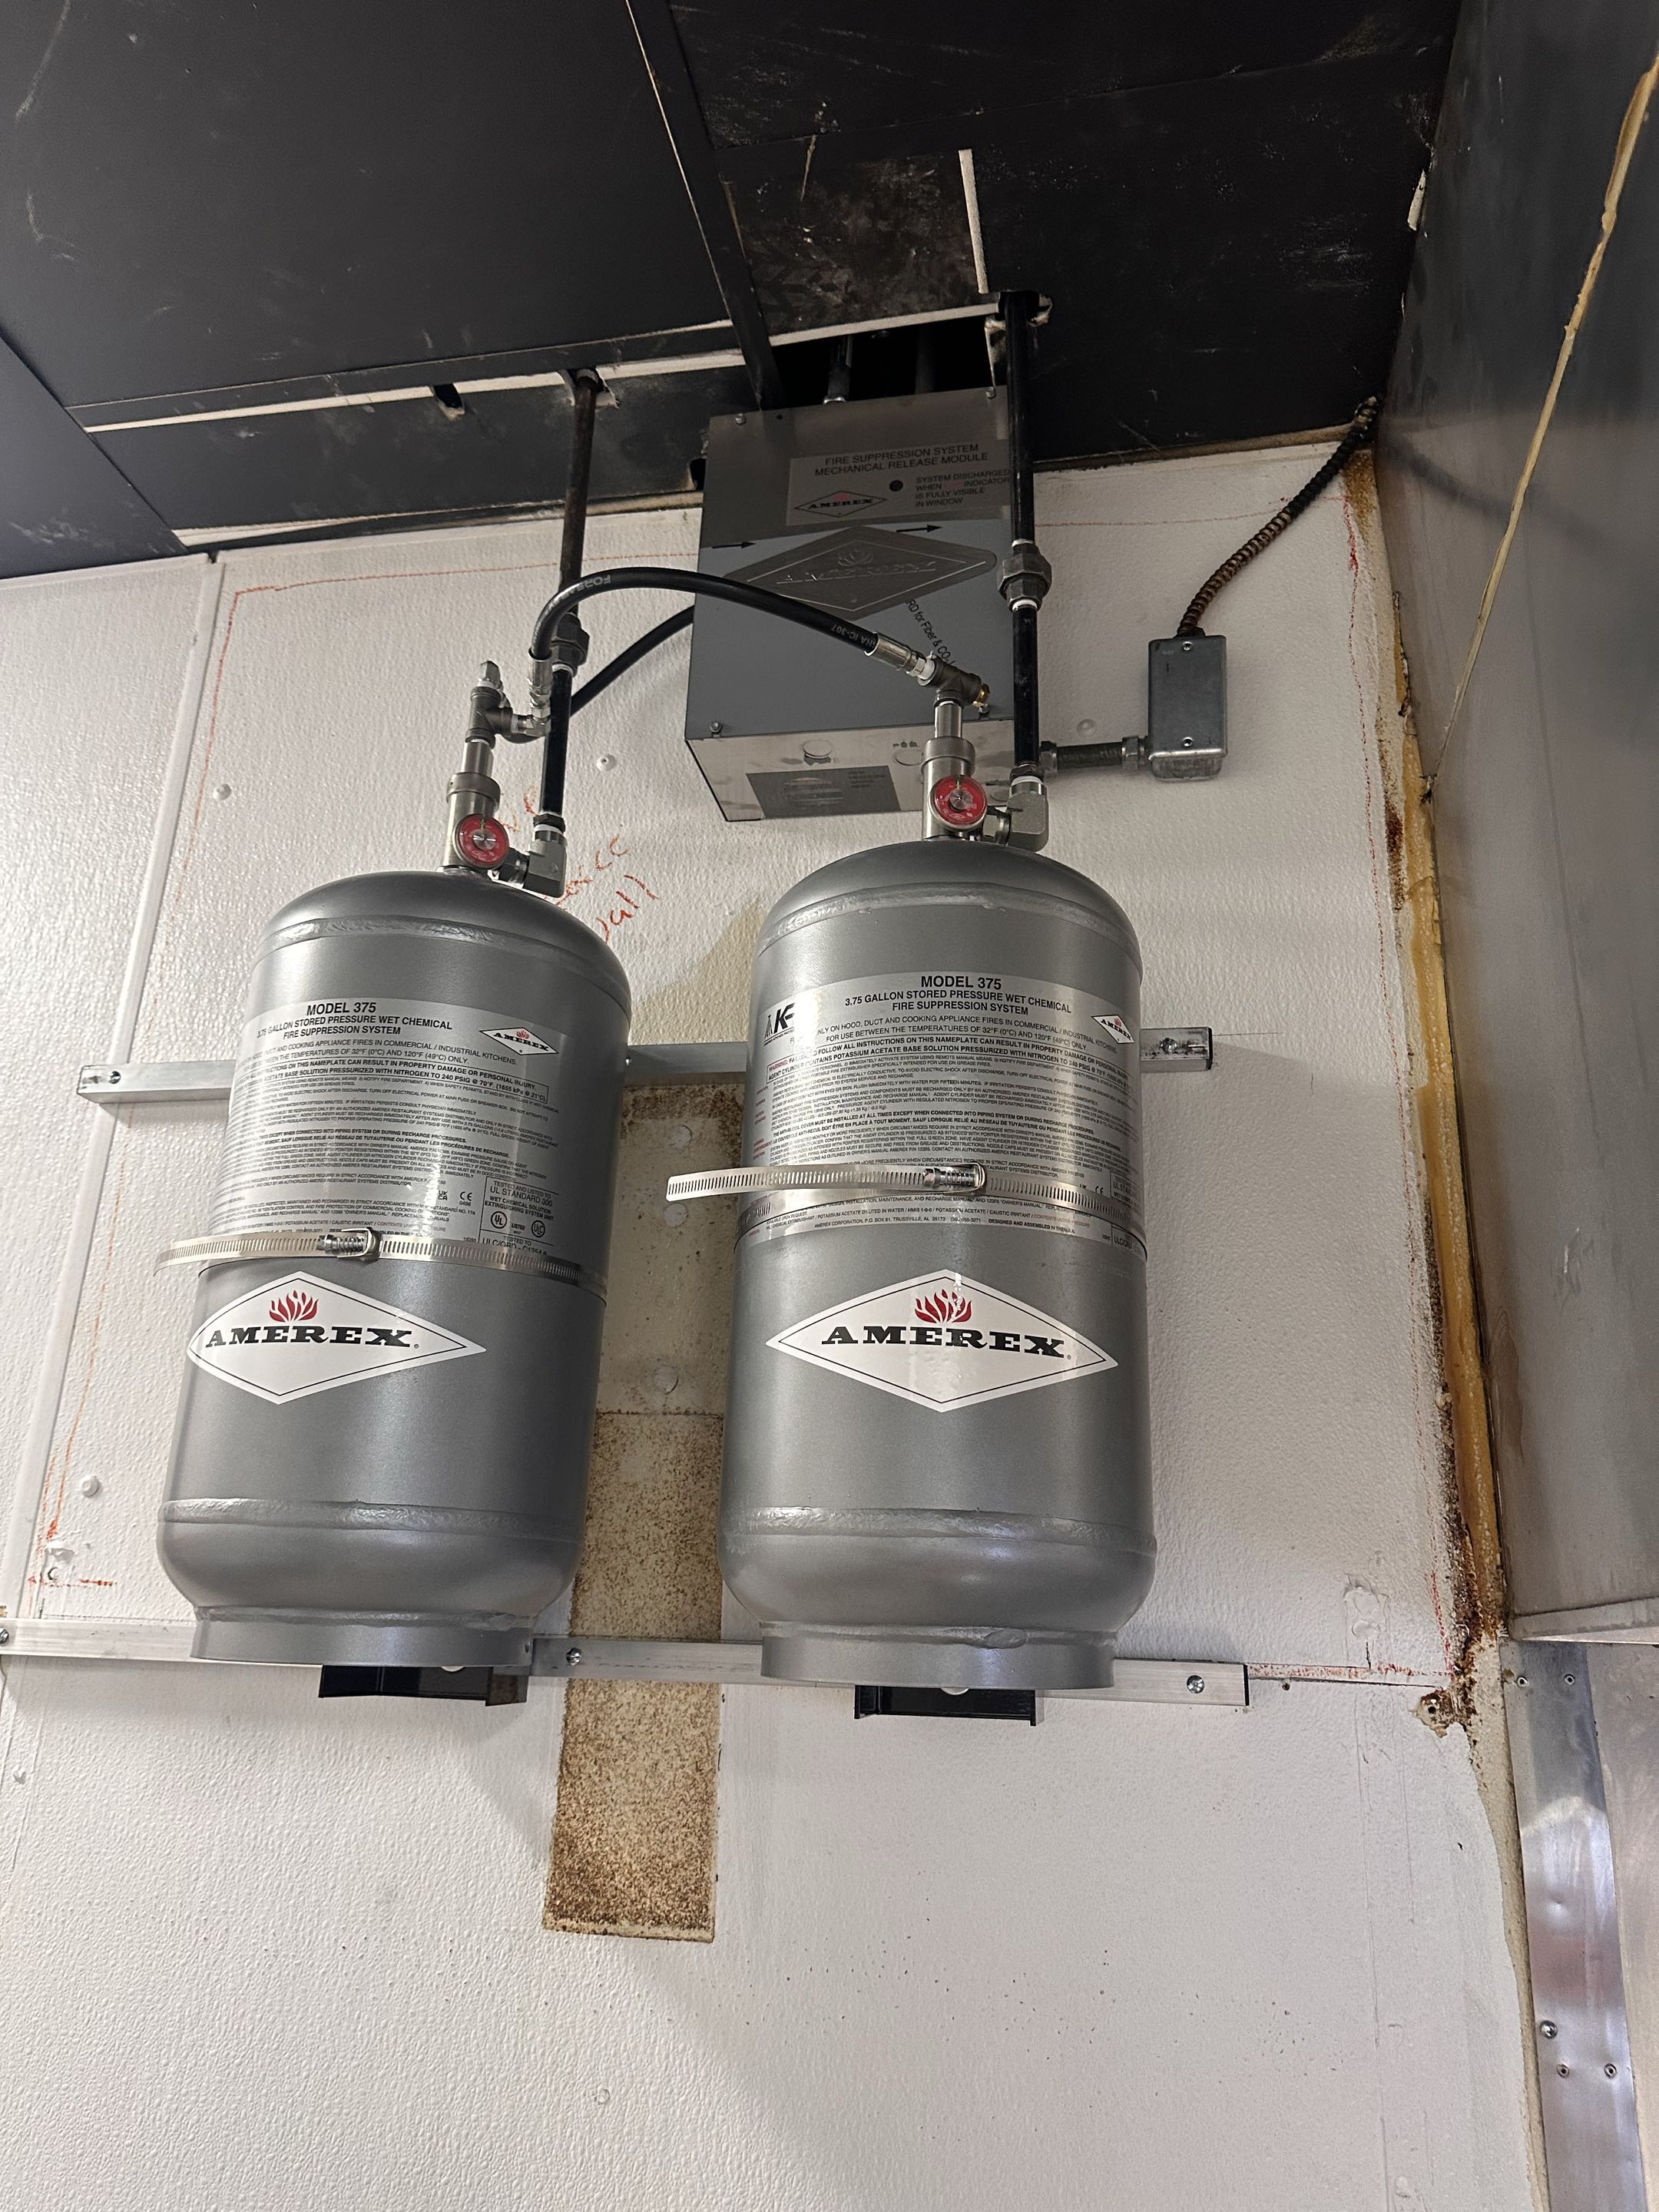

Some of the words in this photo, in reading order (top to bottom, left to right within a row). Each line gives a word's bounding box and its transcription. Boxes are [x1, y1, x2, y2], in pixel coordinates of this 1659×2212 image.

[825, 457, 849, 465] FIRE
[853, 449, 931, 463] SUPPRESSION
[933, 444, 979, 455] SYSTEM
[814, 463, 885, 476] MECHANICAL
[889, 459, 935, 469] RELEASE
[941, 452, 988, 463] MODULE
[916, 475, 951, 484] SYSTEM
[953, 469, 1010, 480] DISCHARGED
[965, 478, 1010, 487] INDICATOR
[925, 490, 952, 498] FULLY
[953, 487, 985, 496] VISIBLE
[808, 498, 873, 509] AMEREX
[925, 498, 963, 507] WINDOW
[914, 611, 926, 622] for
[921, 621, 937, 640] Fiber
[922, 976, 973, 988] MODEL
[978, 977, 1002, 989] 375
[307, 1003, 350, 1015] MODEL
[353, 1002, 376, 1012] 375
[845, 997, 862, 1006] 3.75
[865, 992, 903, 1002] GALLON
[906, 990, 946, 998] STORED
[950, 991, 1002, 1001] PRESSURE
[1005, 994, 1026, 1003] WET
[1028, 997, 1071, 1013] CHEMICAL
[892, 1002, 914, 1011] FIRE
[917, 1002, 987, 1011] SUPPRESSION
[991, 1003, 1028, 1015] SYSTEM
[268, 1022, 293, 1034] GALLON
[295, 1017, 326, 1027] STORED
[328, 1015, 376, 1024] PRESSURE
[402, 1017, 452, 1029] CHEMICAL
[283, 1031, 298, 1039] FIRE
[300, 1026, 359, 1036] SUPPRESSION
[362, 1026, 401, 1035] SYSTEM
[831, 1024, 839, 1032] ON
[842, 1021, 862, 1030] HOOD,
[1014, 1020, 1058, 1034] COMMERCIAL
[1063, 1029, 1094, 1045] INDUSTRIAL
[494, 1032, 549, 1051] AMEREX
[856, 1028, 889, 1037] BETWEEN
[1000, 1028, 1017, 1037] (0°C)
[1035, 1033, 1051, 1042] 120°F
[1053, 1035, 1070, 1046] (49°C)
[1071, 1040, 1088, 1051] ONLY.
[288, 1041, 313, 1049] COOKING
[384, 1040, 432, 1049] COMMERCIAL
[439, 1044, 481, 1057] INDUSTRIAL
[819, 1045, 842, 1055] FOLLOW
[857, 1038, 905, 1048] INSTRUCTIONS
[1031, 1044, 1063, 1056] PROPERTY
[1065, 1050, 1087, 1061] DAMAGE
[833, 1049, 869, 1060] POTASSIUM
[961, 1046, 1008, 1055] PRESSURIZED
[1028, 1051, 1058, 1062] NITROGEN
[291, 1049, 339, 1058] TEMPERATURES
[426, 1052, 446, 1061] (49°C)
[448, 1055, 469, 1065] ONLY.
[392, 1069, 429, 1078] NITROGEN
[496, 1083, 512, 1093] (1655
[513, 1087, 524, 1095] kPa
[399, 1061, 435, 1070] PROPERTY
[438, 1066, 467, 1075] DAMAGE
[479, 1072, 513, 1084] PERSONAL
[515, 1079, 536, 1091] INJURY.
[460, 1191, 472, 1201] CE
[494, 1181, 515, 1189] TESTED
[527, 1188, 544, 1197] LISTED
[502, 1188, 541, 1204] STANDARD
[542, 1199, 552, 1207] 300
[485, 1201, 524, 1214] EXTINGUISHING
[525, 1209, 543, 1217] SYSTEM
[502, 1198, 528, 1208] CHEMICAL
[529, 1204, 551, 1214] SOLUTION
[495, 1215, 503, 1225] UL
[205, 1326, 412, 1349] AMEREX
[821, 1326, 1065, 1358] AMEREX
